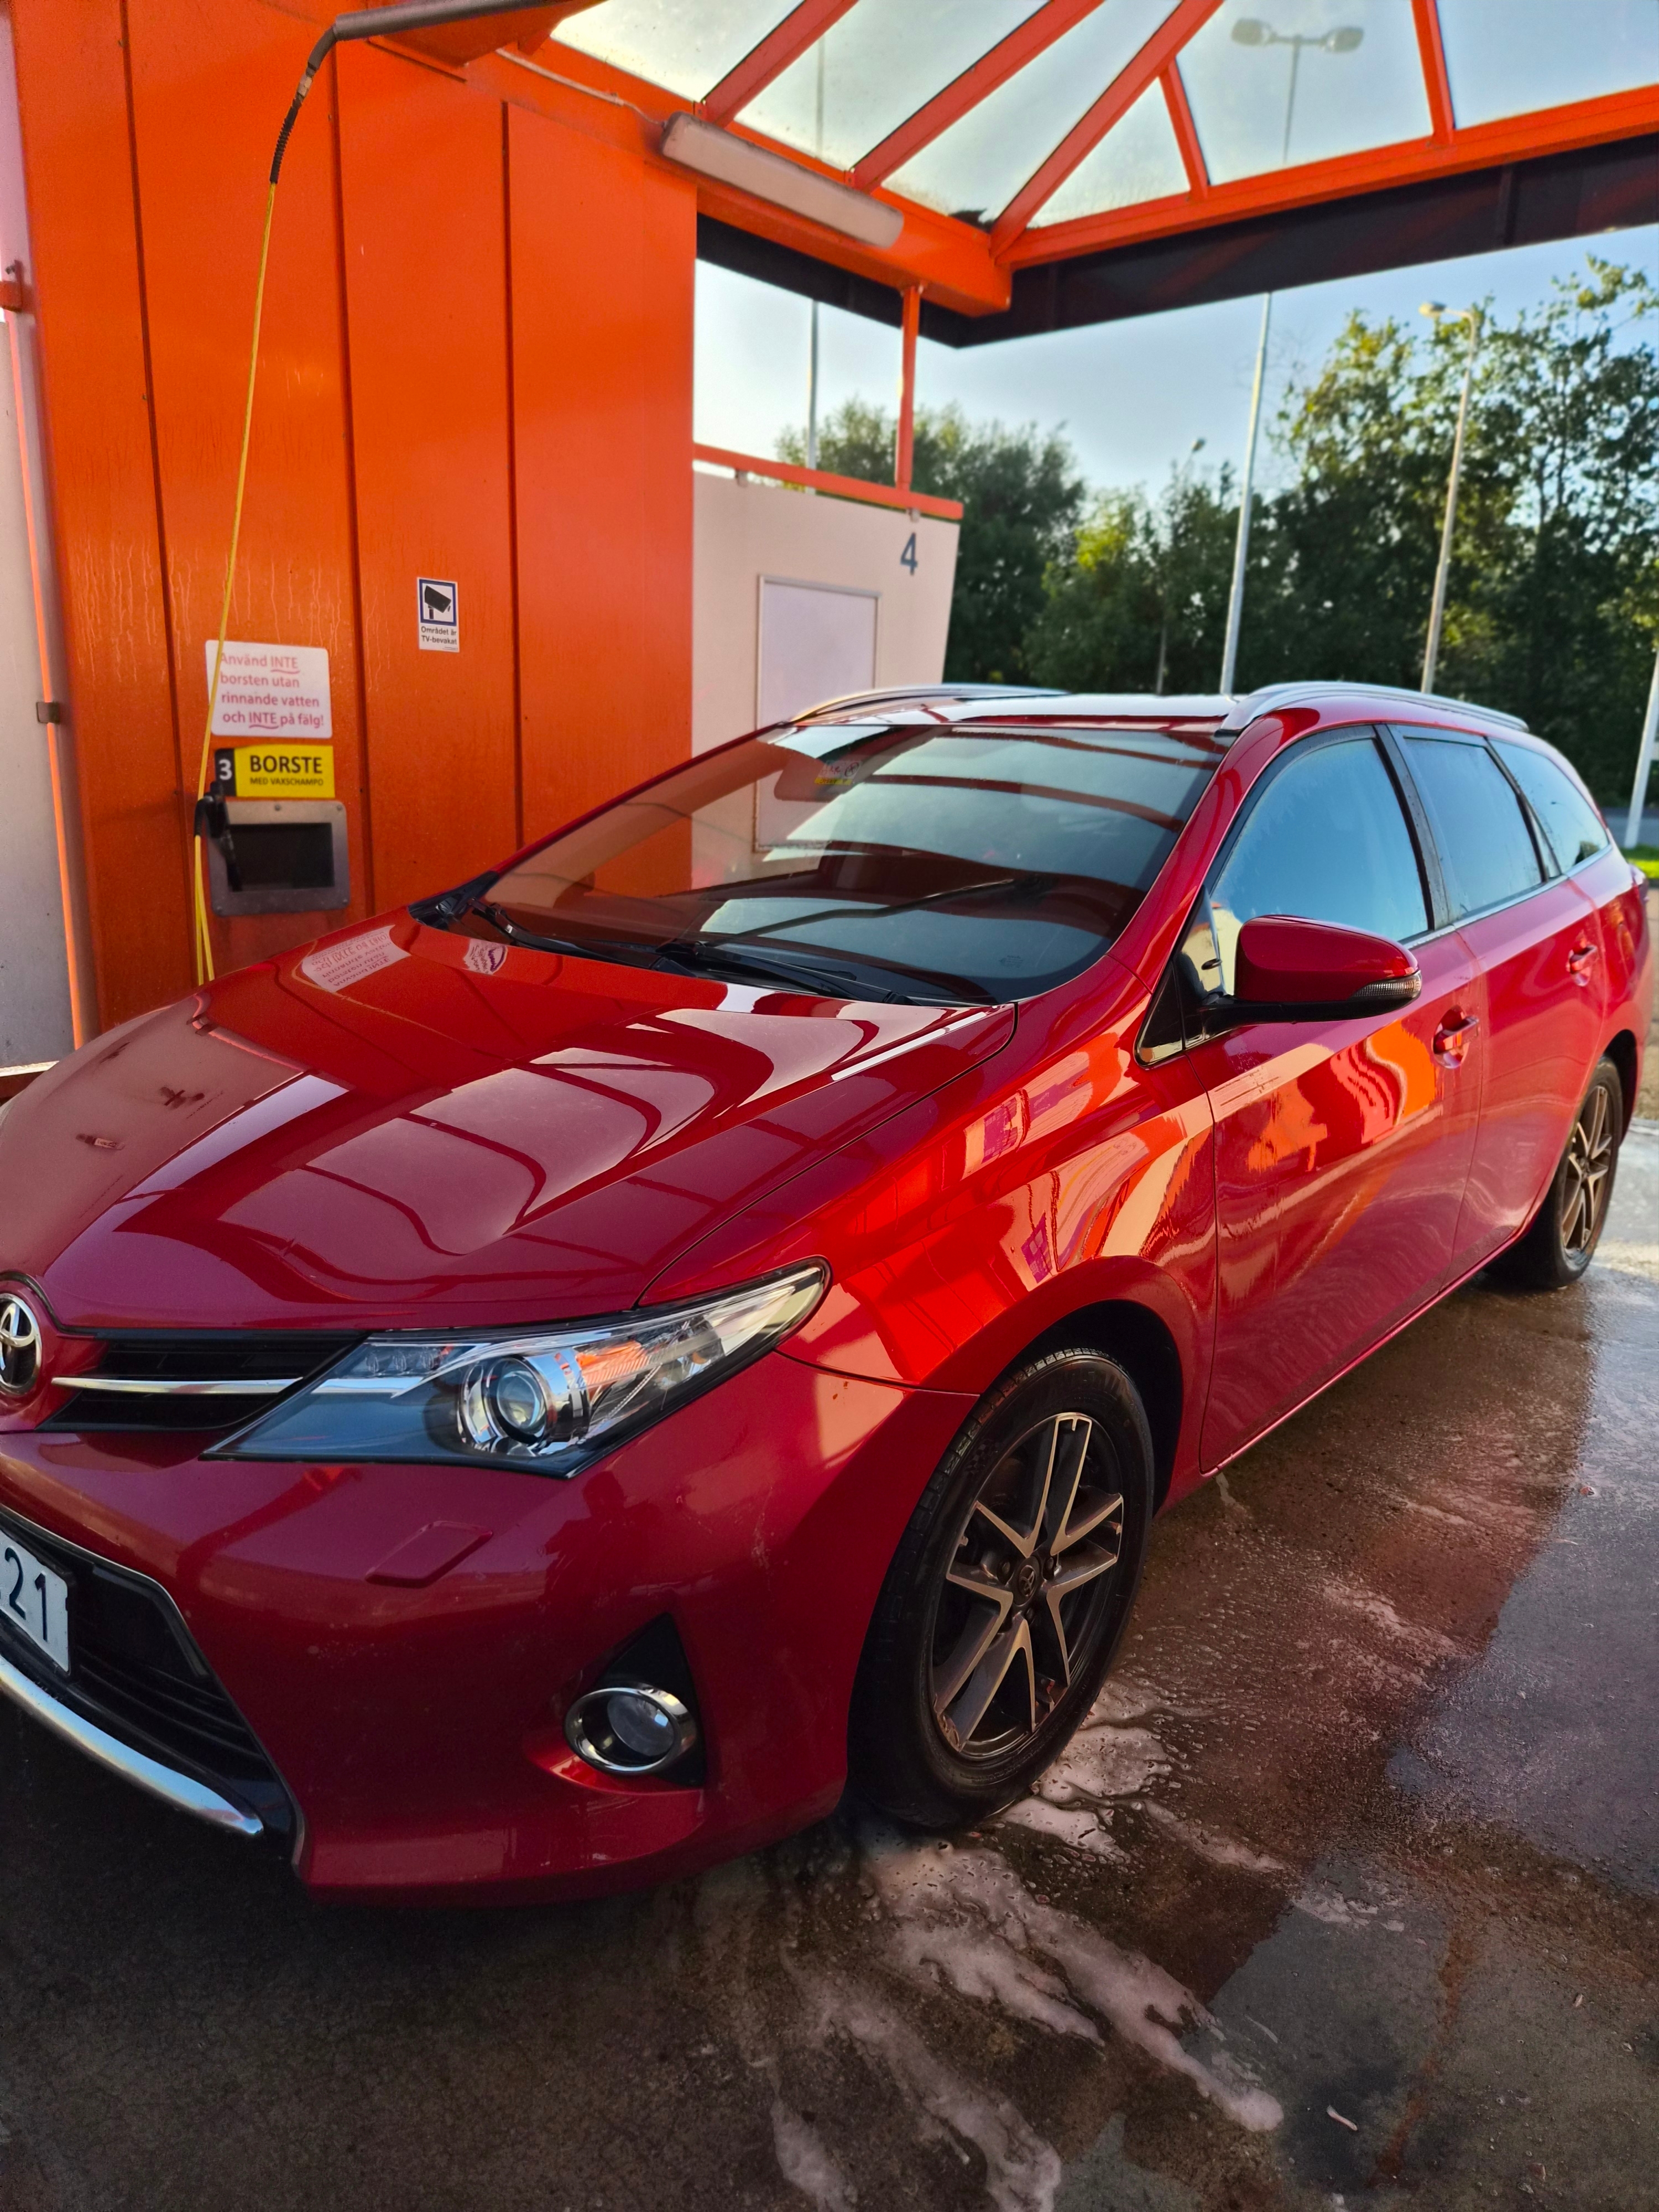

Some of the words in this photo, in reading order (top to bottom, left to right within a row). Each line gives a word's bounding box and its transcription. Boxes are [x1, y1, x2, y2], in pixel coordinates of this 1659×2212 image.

[900, 532, 918, 576] 4
[421, 625, 449, 635] Området
[421, 635, 457, 645] TV-bevakat
[221, 652, 267, 667] Använd
[271, 655, 298, 669] INTE
[221, 671, 269, 686] borsten
[272, 676, 300, 687] utan
[222, 692, 278, 705] rinnande
[281, 695, 319, 707] vatten
[223, 711, 246, 723] och
[249, 712, 276, 724] INTE
[280, 712, 295, 727] på
[298, 713, 324, 729] fälg!
[218, 759, 233, 781] 3
[250, 755, 322, 774] BORSTE
[250, 776, 268, 785] MED
[270, 777, 324, 786] VAXSCHAMPO
[4, 1547, 48, 1642] 21
